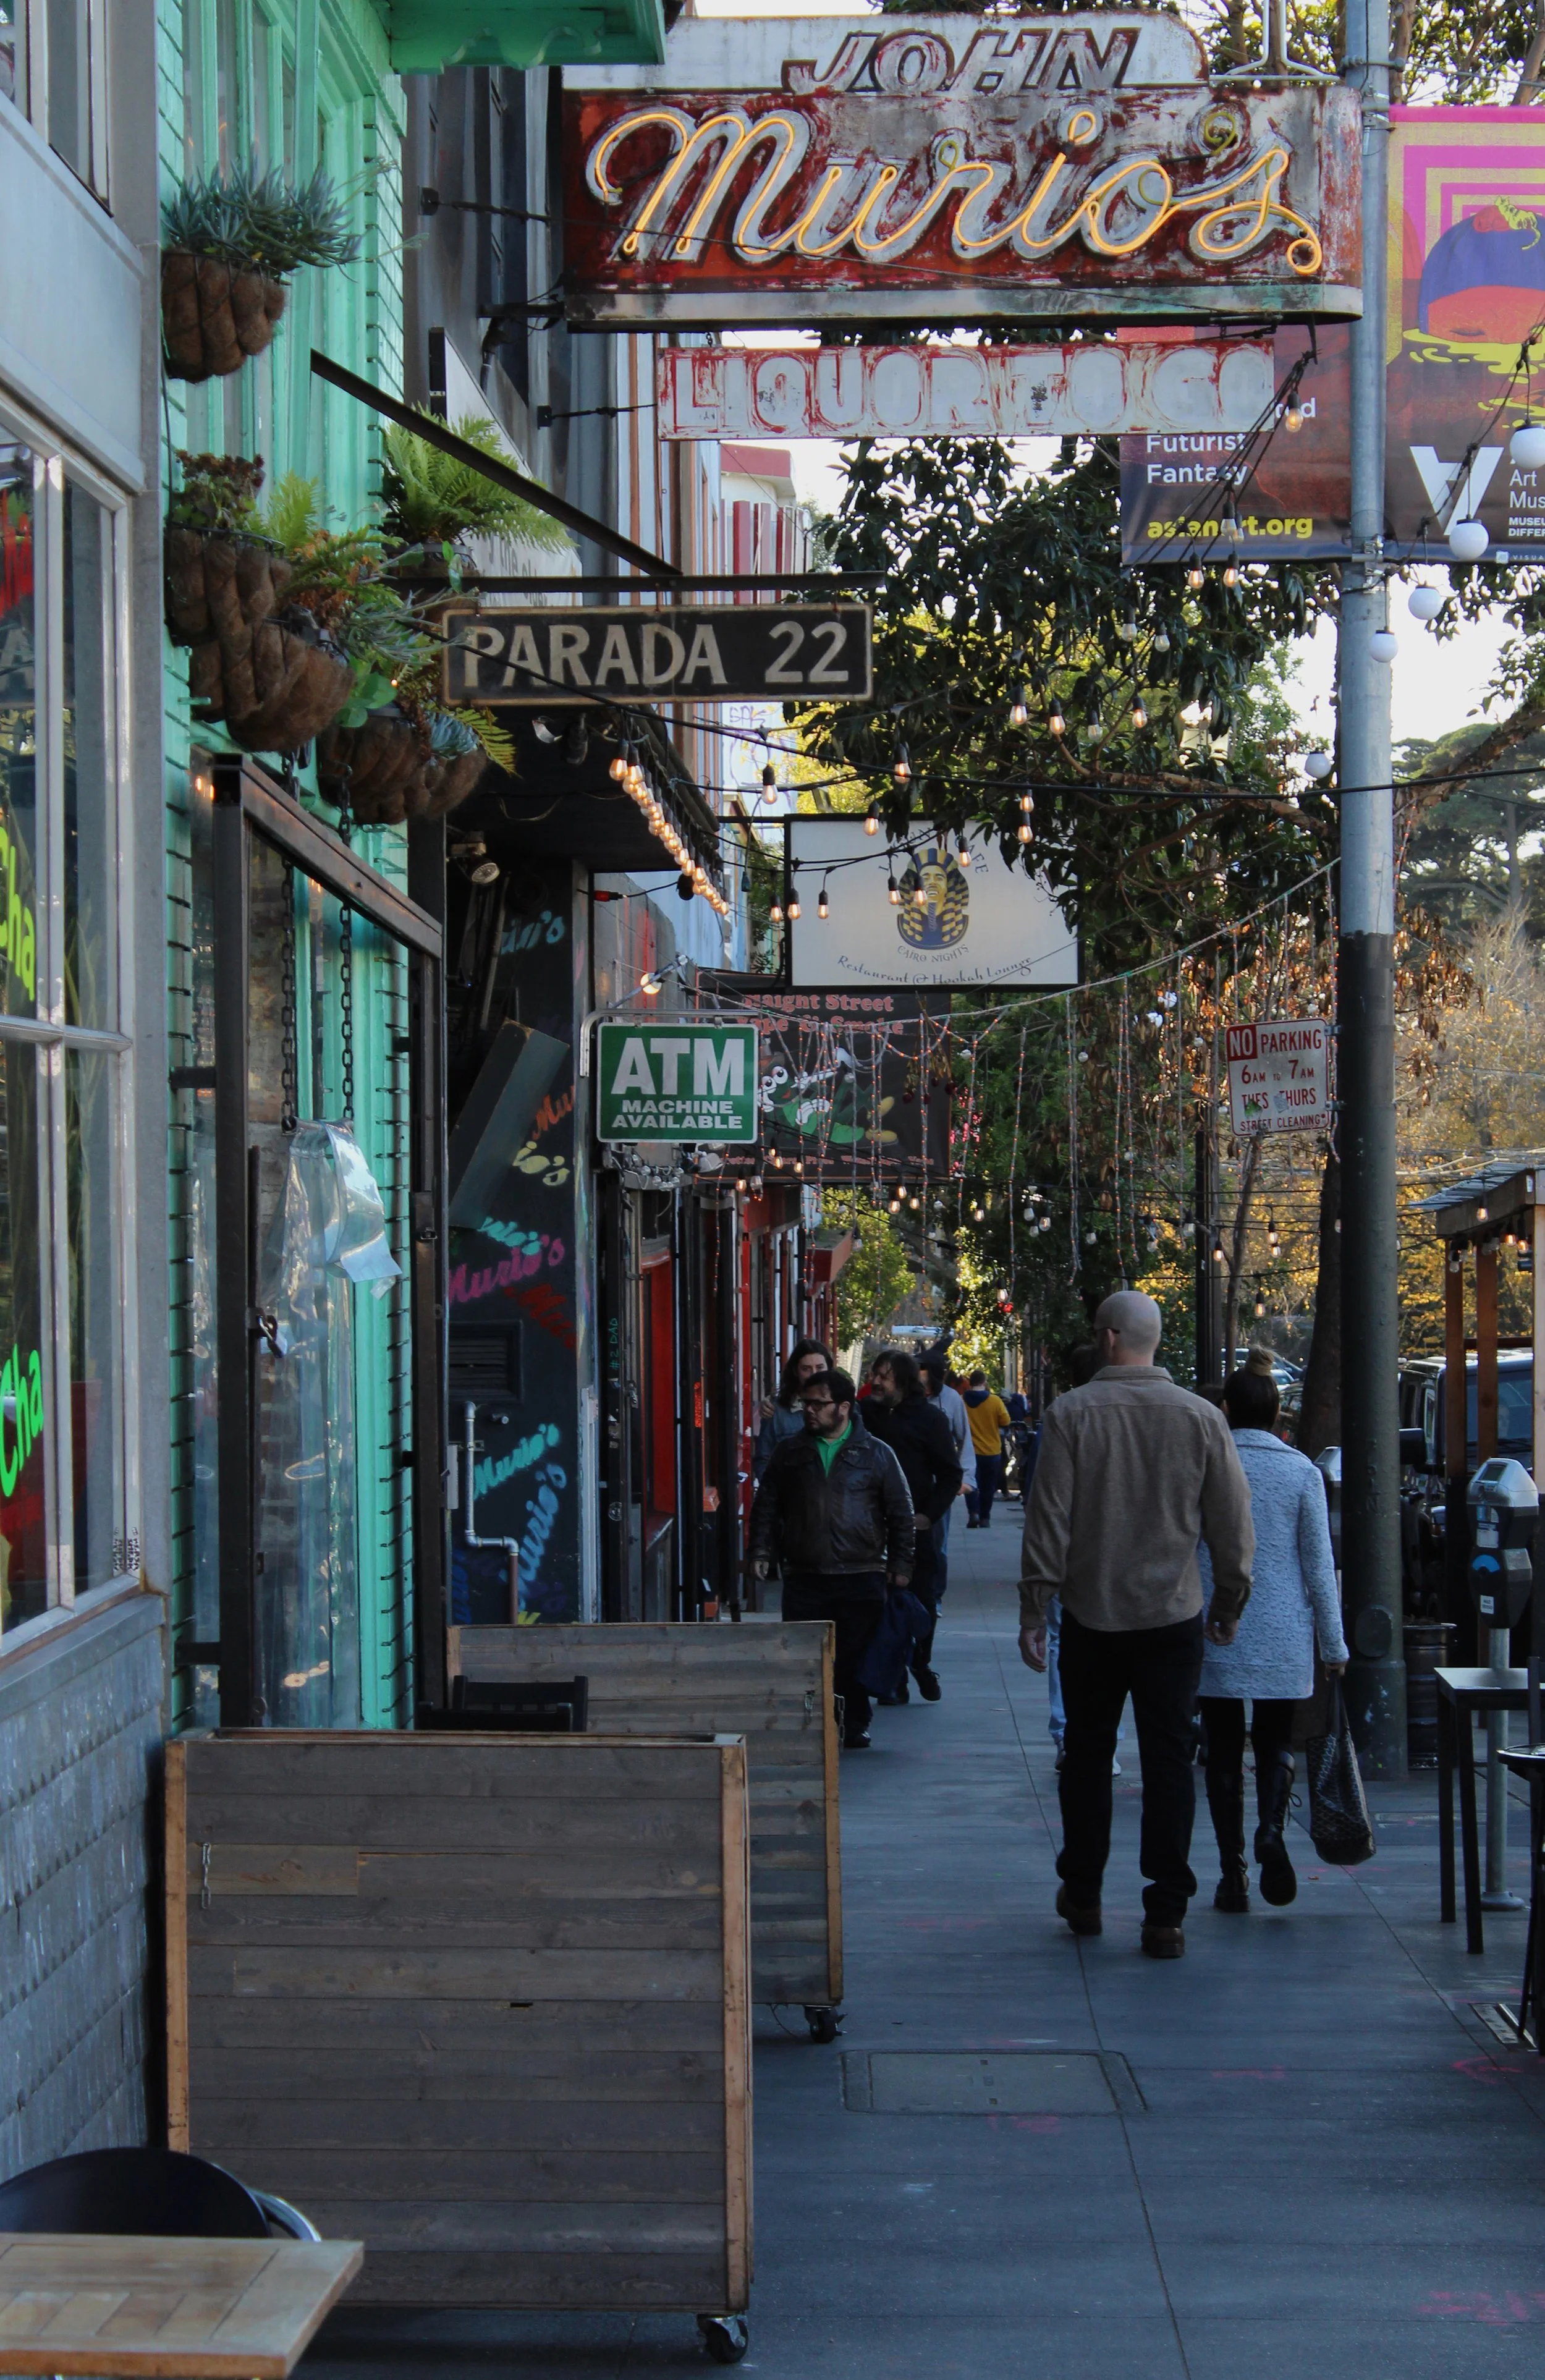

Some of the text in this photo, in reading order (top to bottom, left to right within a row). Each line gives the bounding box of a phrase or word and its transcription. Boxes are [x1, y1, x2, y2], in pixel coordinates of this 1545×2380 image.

[782, 28, 1141, 94] JOHN
[586, 101, 1323, 274] Murio's
[674, 354, 989, 428] LIQUOR
[1146, 433, 1247, 453] Futurist
[1509, 468, 1538, 486] Art
[464, 621, 849, 687] PARADA 22
[931, 944, 969, 962] NIGHTS
[837, 955, 910, 983] Restaurant
[932, 968, 983, 985] Hookah
[987, 957, 1031, 976] Lounge
[825, 994, 894, 1011] Street
[1230, 1028, 1322, 1057] NO PARKING
[611, 1037, 745, 1096] ATM
[1273, 1073, 1281, 1081] TO
[622, 1099, 734, 1114] MACHINE
[611, 1114, 743, 1129] AVAILABLE
[1277, 1114, 1321, 1129] CLEANING
